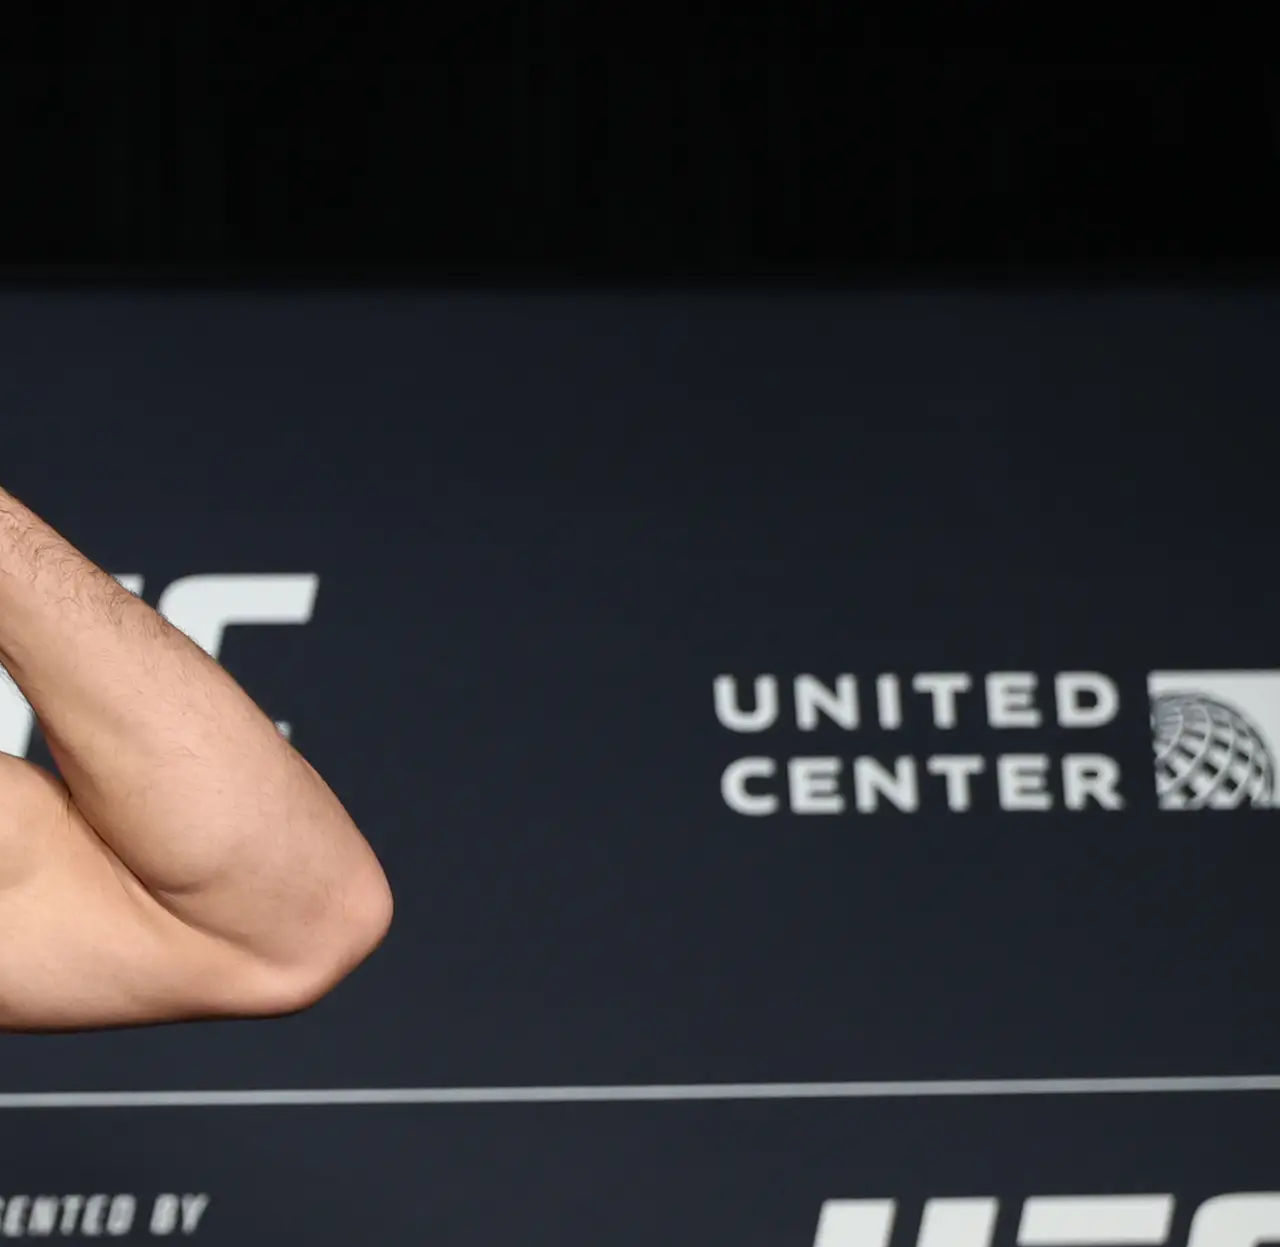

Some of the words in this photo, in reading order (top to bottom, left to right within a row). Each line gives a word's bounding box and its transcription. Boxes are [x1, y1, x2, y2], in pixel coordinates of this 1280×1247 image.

[712, 670, 1120, 733] UNITED
[720, 752, 1124, 816] CENTER
[150, 1193, 210, 1235] BY
